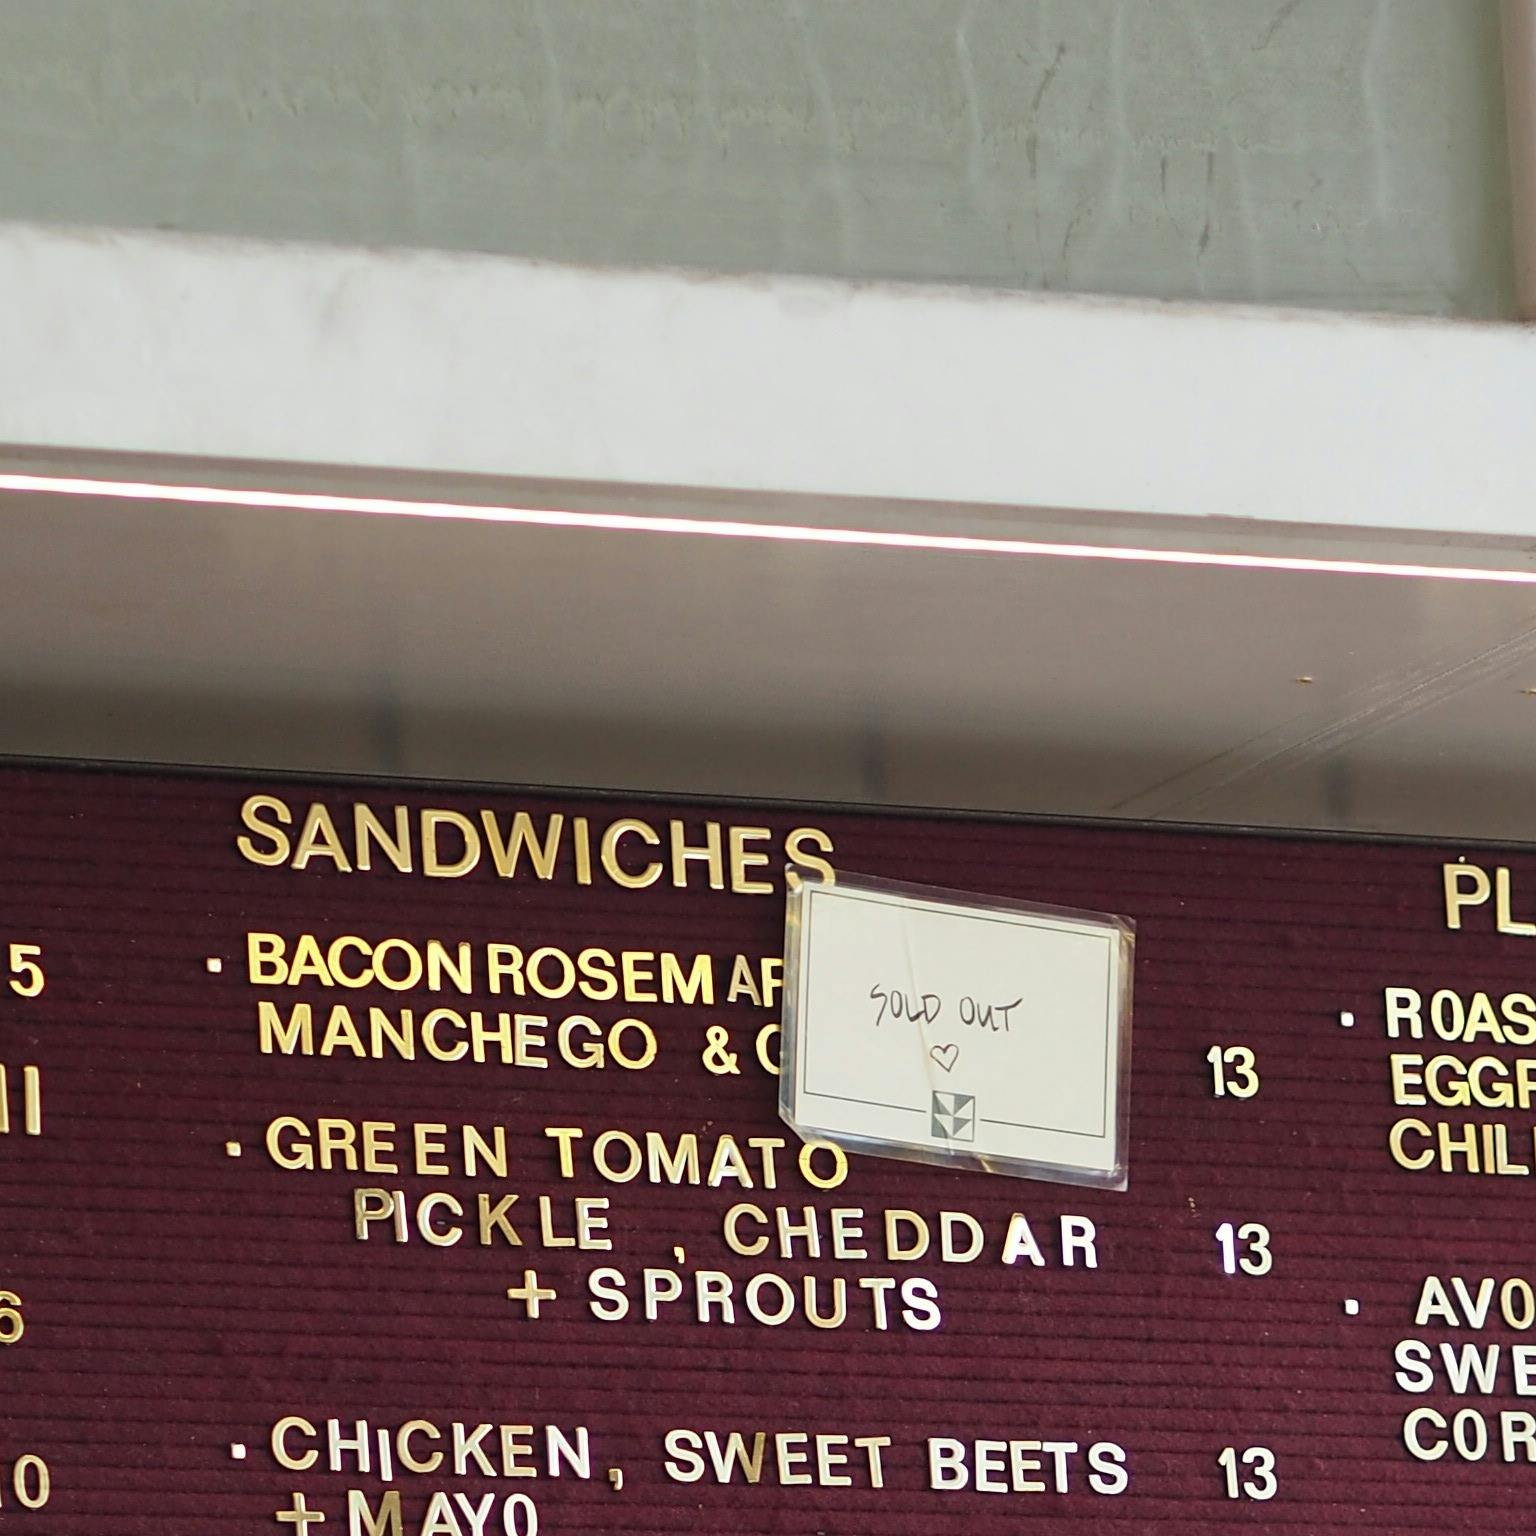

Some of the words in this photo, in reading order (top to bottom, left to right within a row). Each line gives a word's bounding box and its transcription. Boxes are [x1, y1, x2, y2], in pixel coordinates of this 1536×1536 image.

[236, 794, 836, 894] SANDWICHES
[10, 944, 44, 997] 5
[248, 933, 472, 994] BACON
[258, 1001, 657, 1069] MANCHEGO
[702, 1026, 740, 1074] &
[870, 983, 942, 1027] SOLD
[959, 996, 1026, 1034] OUT
[1207, 1046, 1259, 1098] 13
[266, 1117, 507, 1177] GREEN
[543, 1126, 851, 1191] TOMATO
[724, 1204, 1097, 1268] CHEDDAR
[1216, 1223, 1272, 1275] 13
[589, 1268, 941, 1330] SPROUTS
[665, 1430, 891, 1488] SWEET
[928, 1438, 1128, 1494] BEETS
[1218, 1447, 1277, 1499] 13
